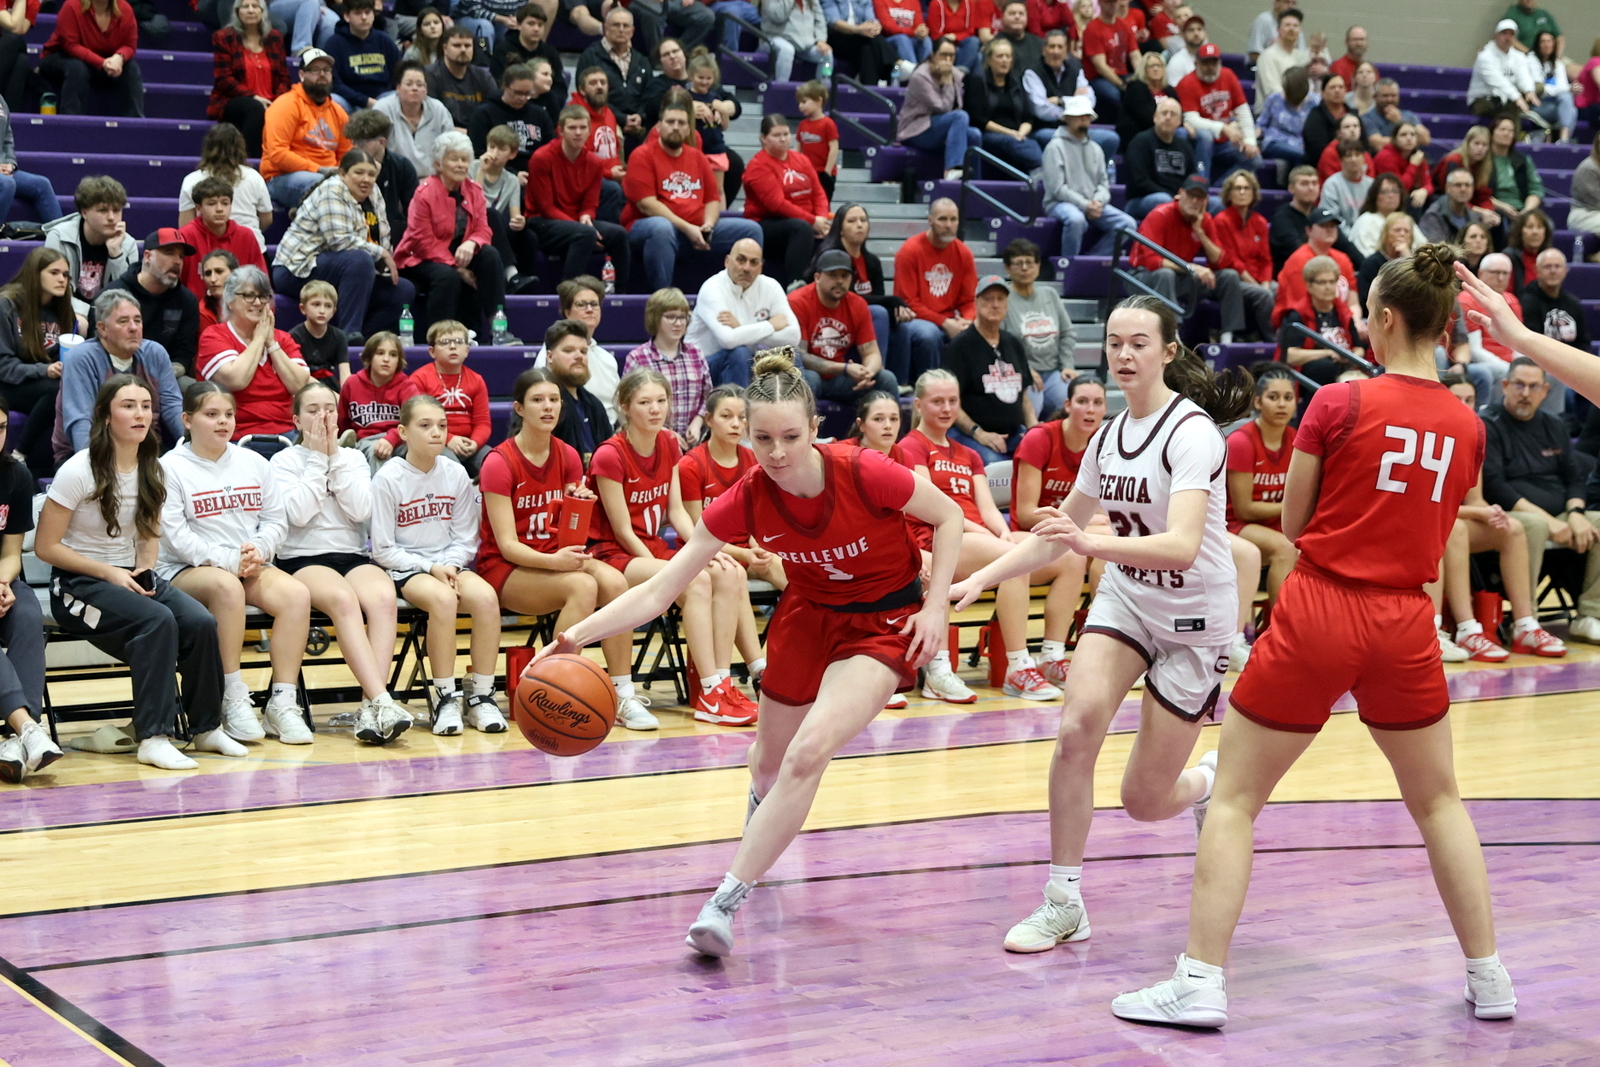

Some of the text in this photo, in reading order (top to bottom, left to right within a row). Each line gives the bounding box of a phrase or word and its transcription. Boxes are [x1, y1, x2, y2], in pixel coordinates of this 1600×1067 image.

[349, 401, 401, 418] Redme
[1375, 424, 1456, 503] 24
[988, 478, 1011, 488] BLU
[1045, 478, 1075, 492] BELL
[192, 492, 263, 514] BELLEVUE
[397, 502, 453, 523] BELLEVU
[643, 504, 662, 537] 11
[777, 536, 870, 564] BELLEVUE
[528, 689, 591, 728] Rawlings
